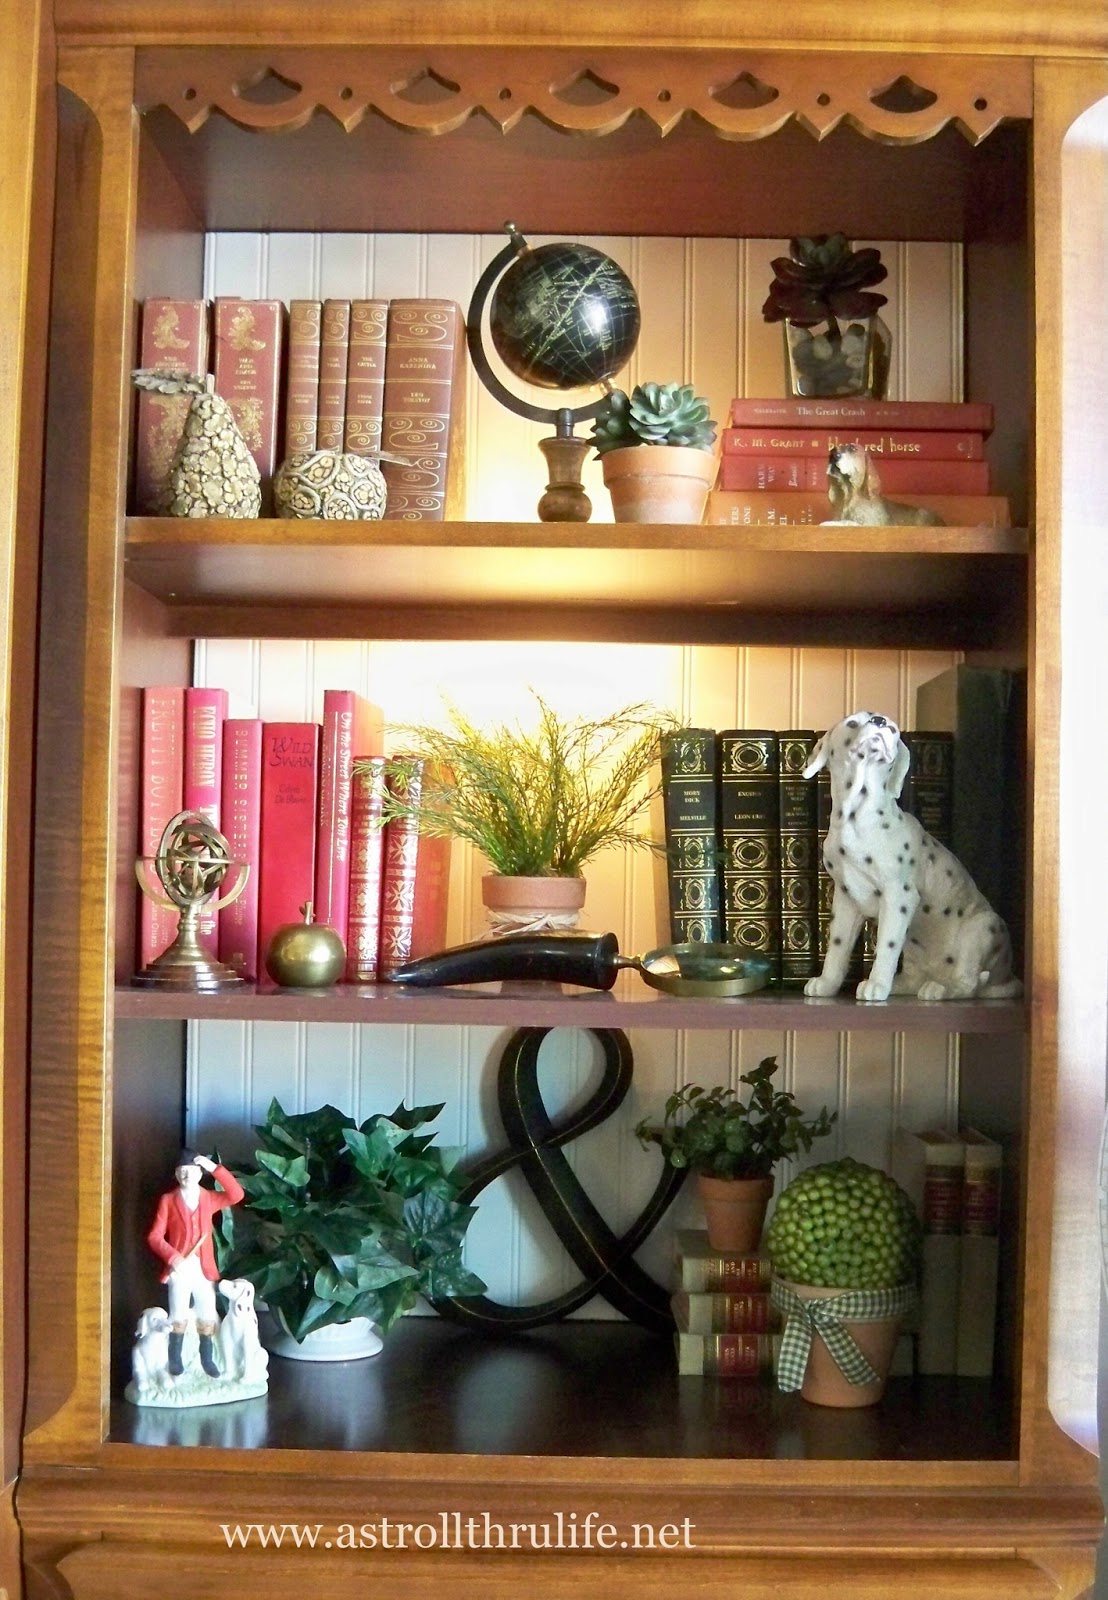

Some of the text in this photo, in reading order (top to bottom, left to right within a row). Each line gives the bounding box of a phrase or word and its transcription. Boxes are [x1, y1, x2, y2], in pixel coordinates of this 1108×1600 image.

[796, 406, 813, 416] The
[815, 406, 839, 416] Great
[841, 406, 866, 416] Crash
[734, 438, 748, 448] K.
[770, 438, 806, 448] GRANT
[864, 437, 884, 453] red
[889, 437, 921, 453] horse
[193, 705, 217, 739] ECHO
[272, 736, 313, 753] WILD
[192, 743, 216, 788] HERON
[269, 753, 314, 768] SWAN
[233, 730, 249, 859] SUMMER SISTERS
[336, 712, 353, 861] On the Street Where You Live
[200, 920, 217, 935] the
